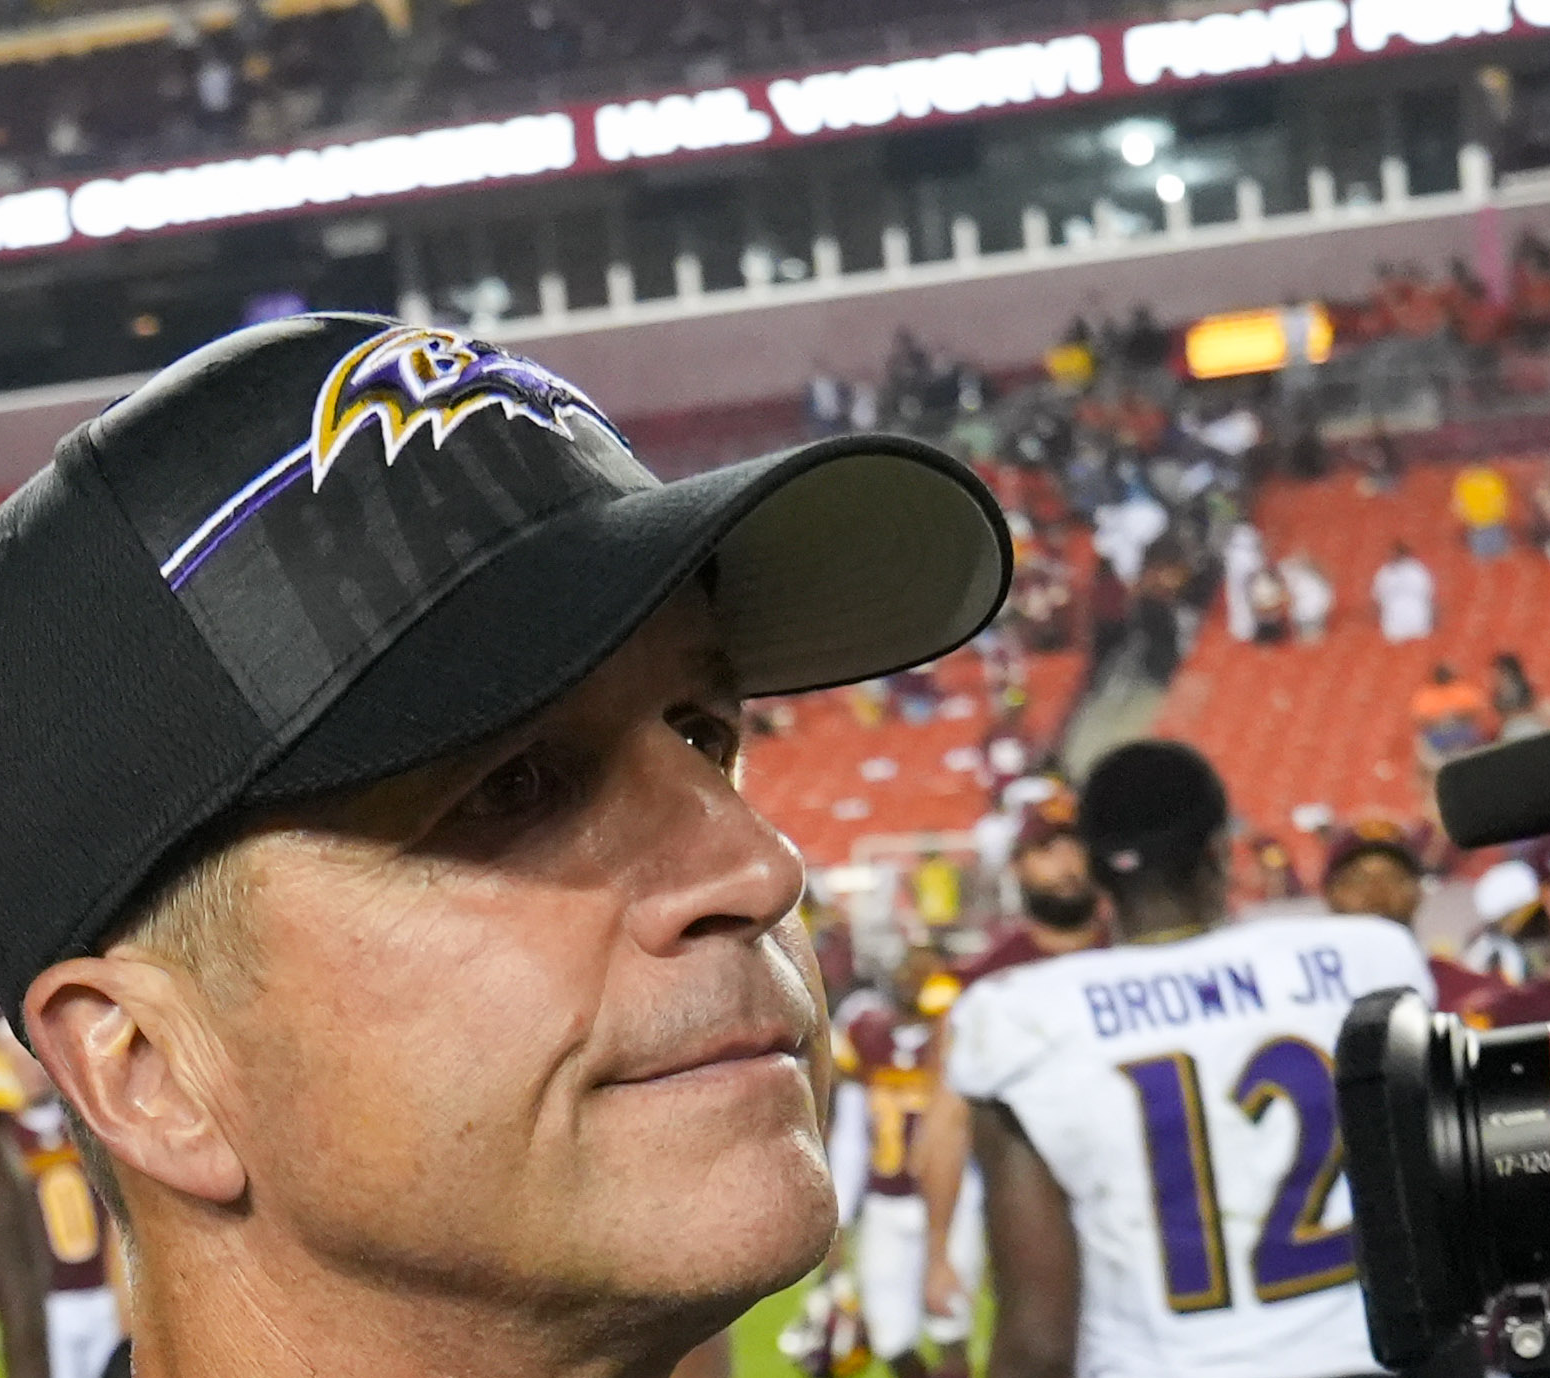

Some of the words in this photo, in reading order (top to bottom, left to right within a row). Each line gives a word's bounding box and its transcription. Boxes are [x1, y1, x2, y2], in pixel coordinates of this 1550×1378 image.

[1083, 963, 1264, 1038] BROWN
[1291, 944, 1352, 1004] JR
[1114, 1035, 1358, 1313] 12
